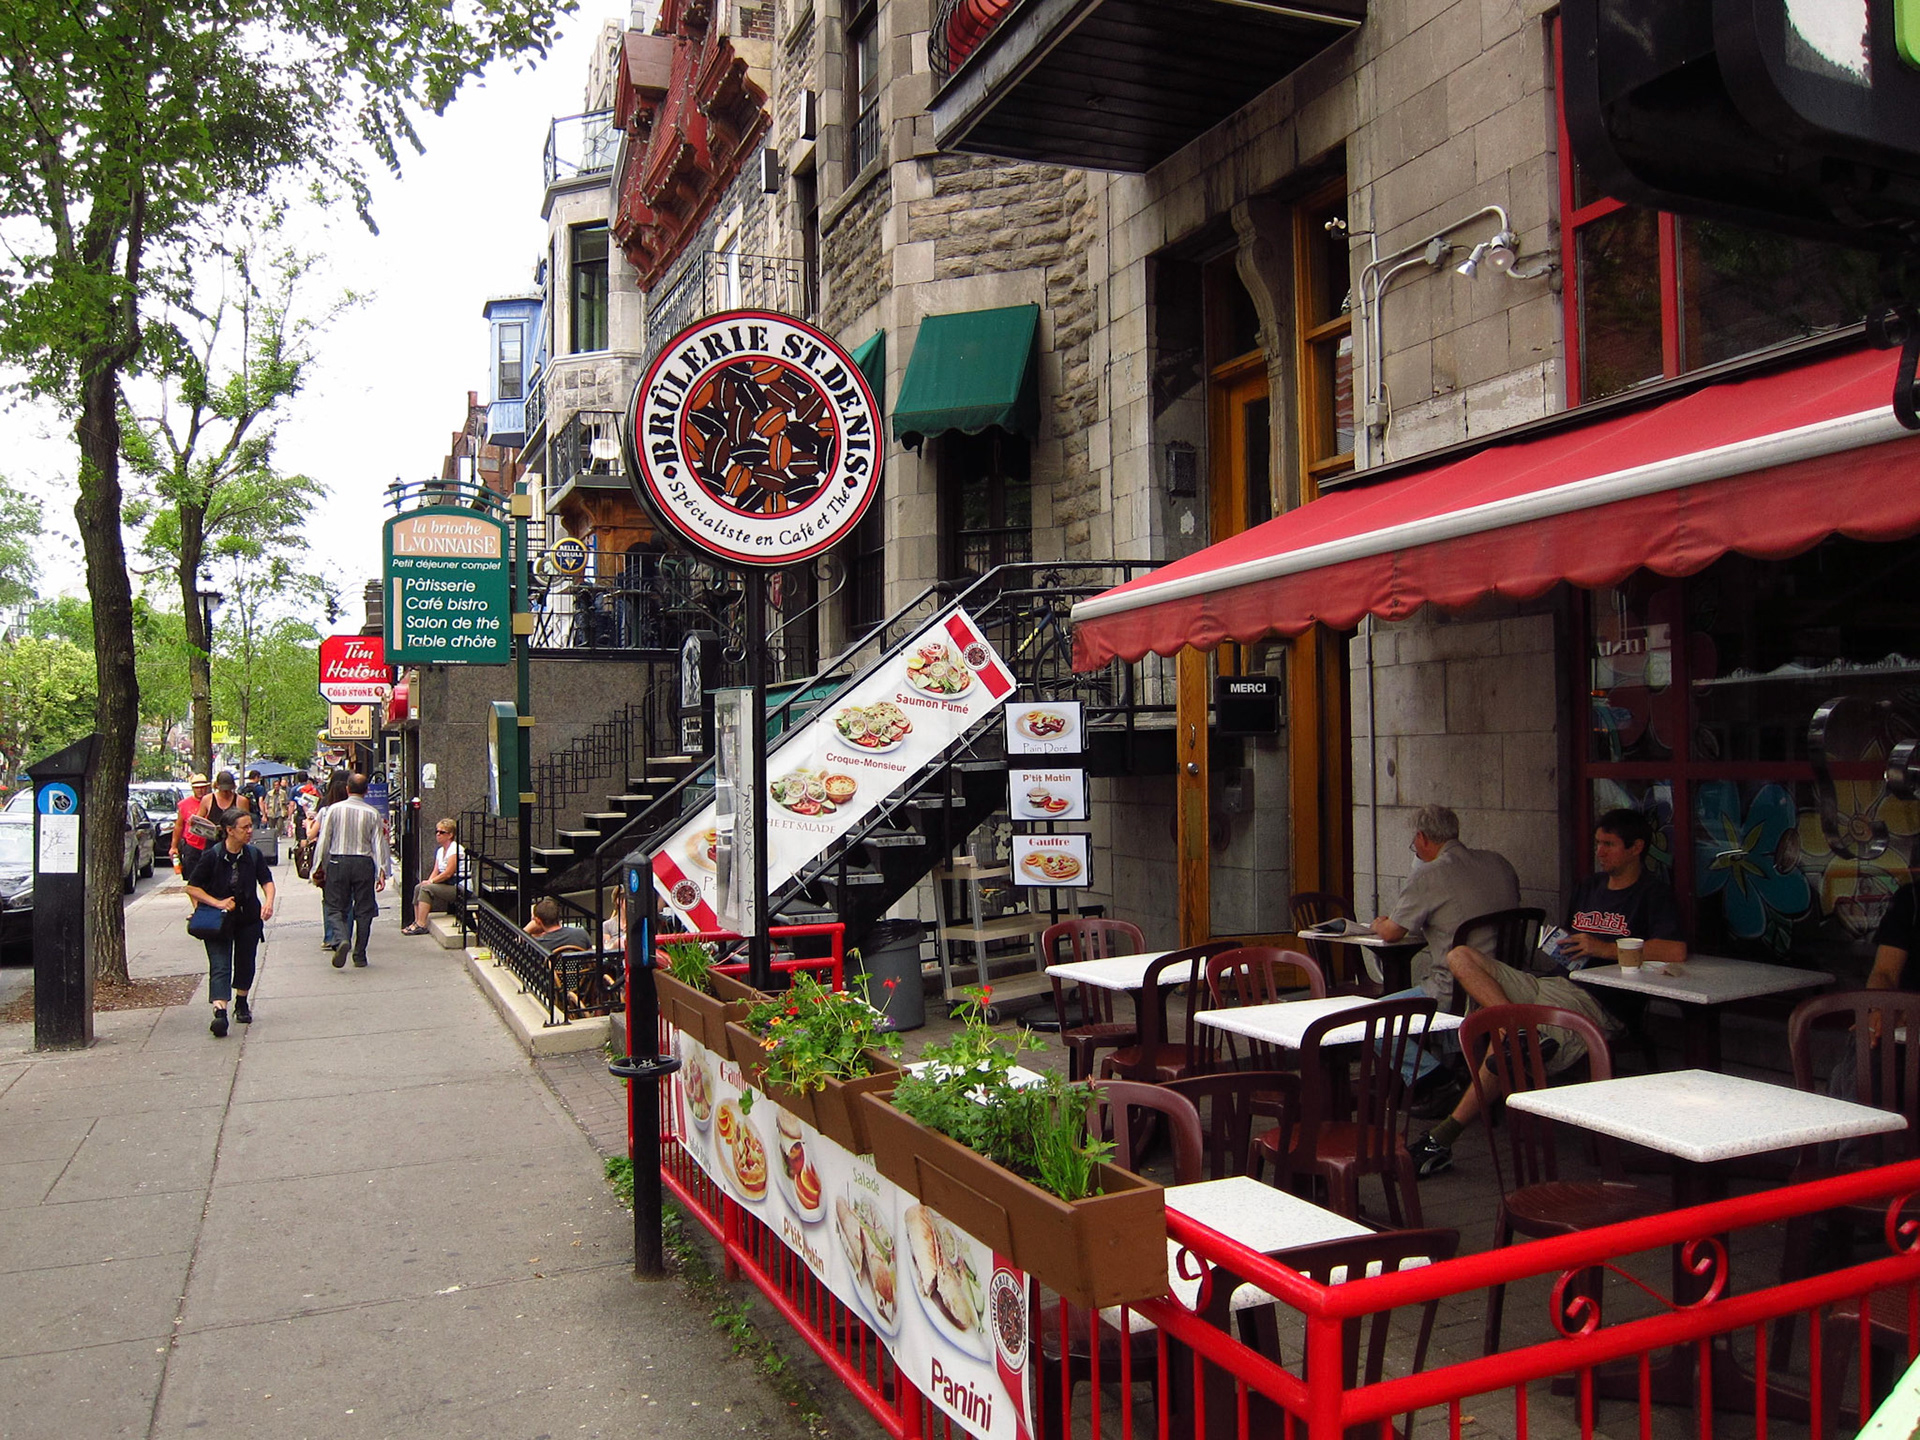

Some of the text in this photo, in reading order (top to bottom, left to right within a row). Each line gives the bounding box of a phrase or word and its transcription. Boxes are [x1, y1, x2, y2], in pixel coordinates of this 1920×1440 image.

[649, 326, 769, 466] BRÛLERIE
[668, 481, 851, 547] Spécialiste en Café et Thé
[412, 519, 482, 536] la brioche
[399, 533, 496, 555] LYONNAISE
[392, 558, 502, 571] Petit déjeuner complet
[405, 578, 476, 593] Pâtisserie
[405, 596, 489, 612] Café bistro
[405, 615, 500, 630] Salon de thé
[406, 633, 497, 648] Table d'hôte
[344, 641, 374, 660] Tim
[326, 659, 387, 679] Hortons
[1230, 683, 1267, 693] MERCI
[895, 693, 969, 714] Saumon Fumé
[826, 752, 907, 773] Croque-Monsieur
[1022, 774, 1071, 782] P'tit Matin
[797, 822, 836, 834] SALADE
[853, 1167, 880, 1196] Salade
[930, 1356, 993, 1432] Panini
